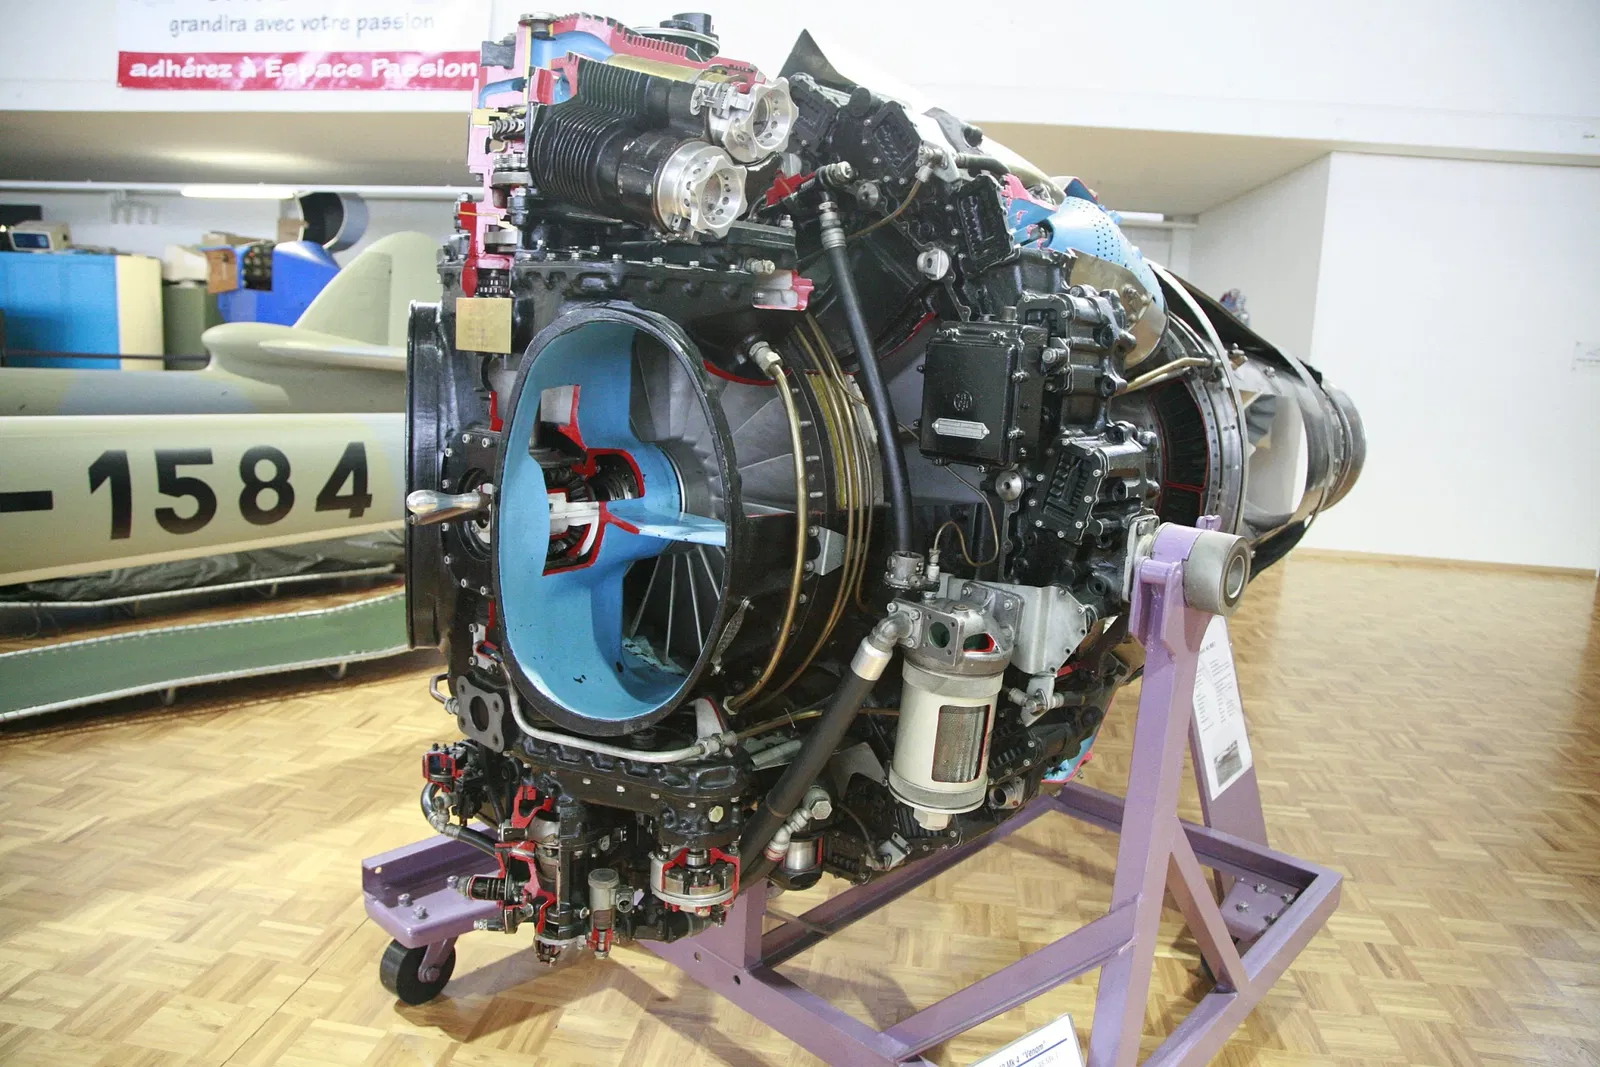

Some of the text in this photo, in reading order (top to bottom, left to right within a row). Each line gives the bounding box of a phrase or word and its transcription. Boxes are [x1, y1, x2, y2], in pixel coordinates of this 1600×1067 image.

[169, 13, 434, 38] grandira avec votre passion
[129, 56, 478, 83] adhérez à Espace Passion
